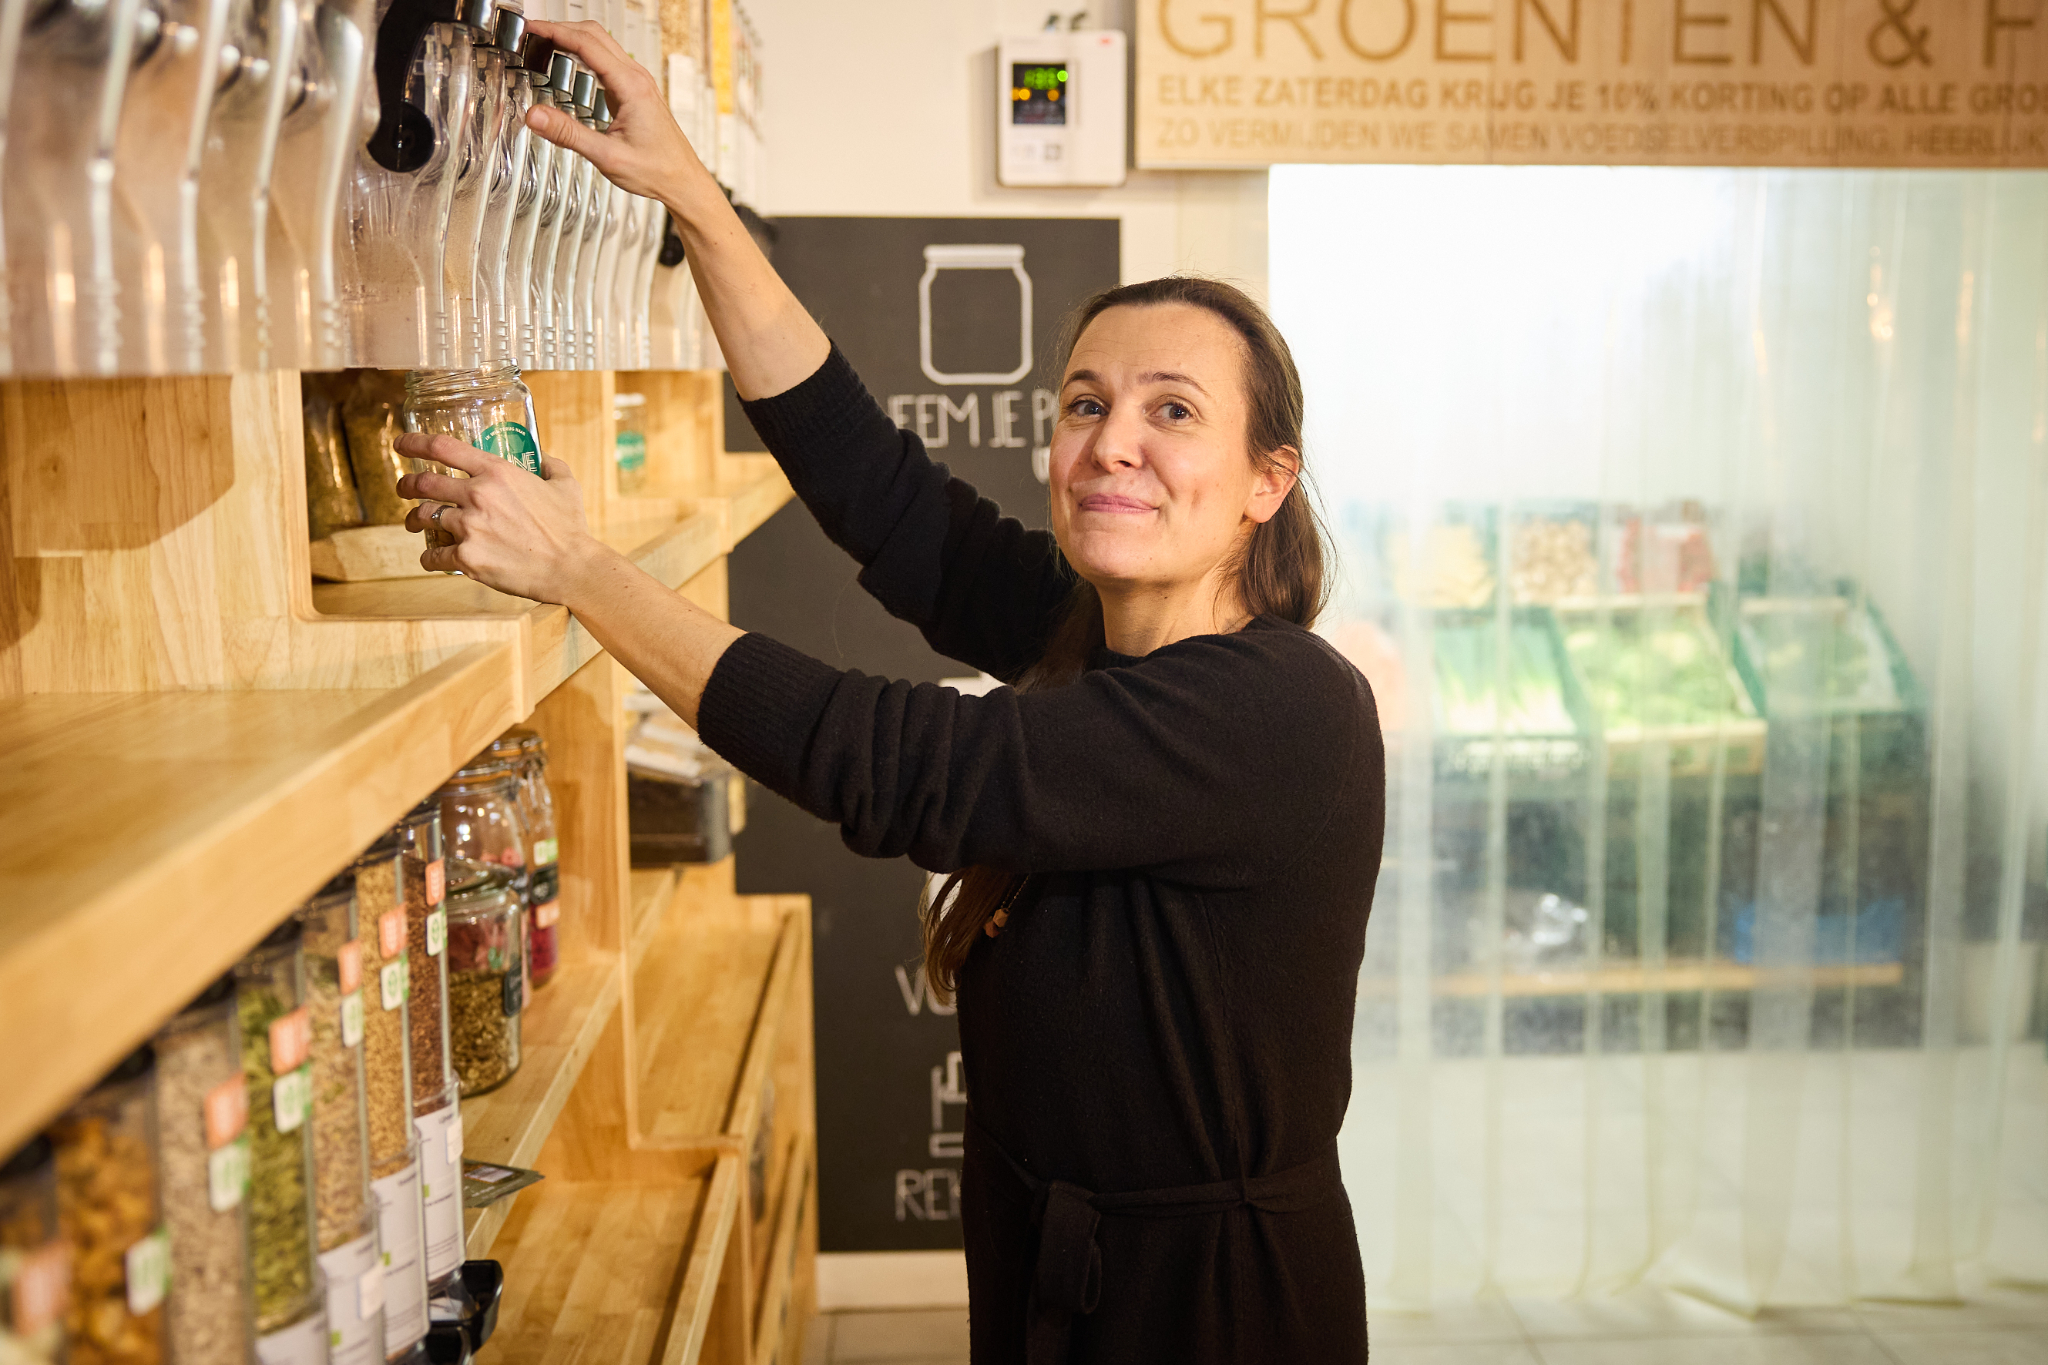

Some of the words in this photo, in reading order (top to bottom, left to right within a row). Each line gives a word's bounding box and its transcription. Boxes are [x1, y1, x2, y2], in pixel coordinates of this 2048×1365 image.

[1866, 0, 1931, 68] &
[1157, 74, 1243, 107] ELKE
[1254, 76, 1430, 110] ZATERDAG
[1438, 79, 1538, 112] KRIJG
[1546, 80, 1586, 112] JE
[1596, 80, 1660, 114] 10%
[1668, 81, 1815, 115] KORTING
[1822, 82, 1870, 115] OP
[1877, 82, 1958, 115] ALLE
[1156, 117, 1201, 149] ZO
[1206, 118, 1381, 151] VERMIJDEN
[1388, 120, 1438, 153] WE
[1444, 122, 1550, 153] SAMEN
[888, 392, 980, 448] EEM
